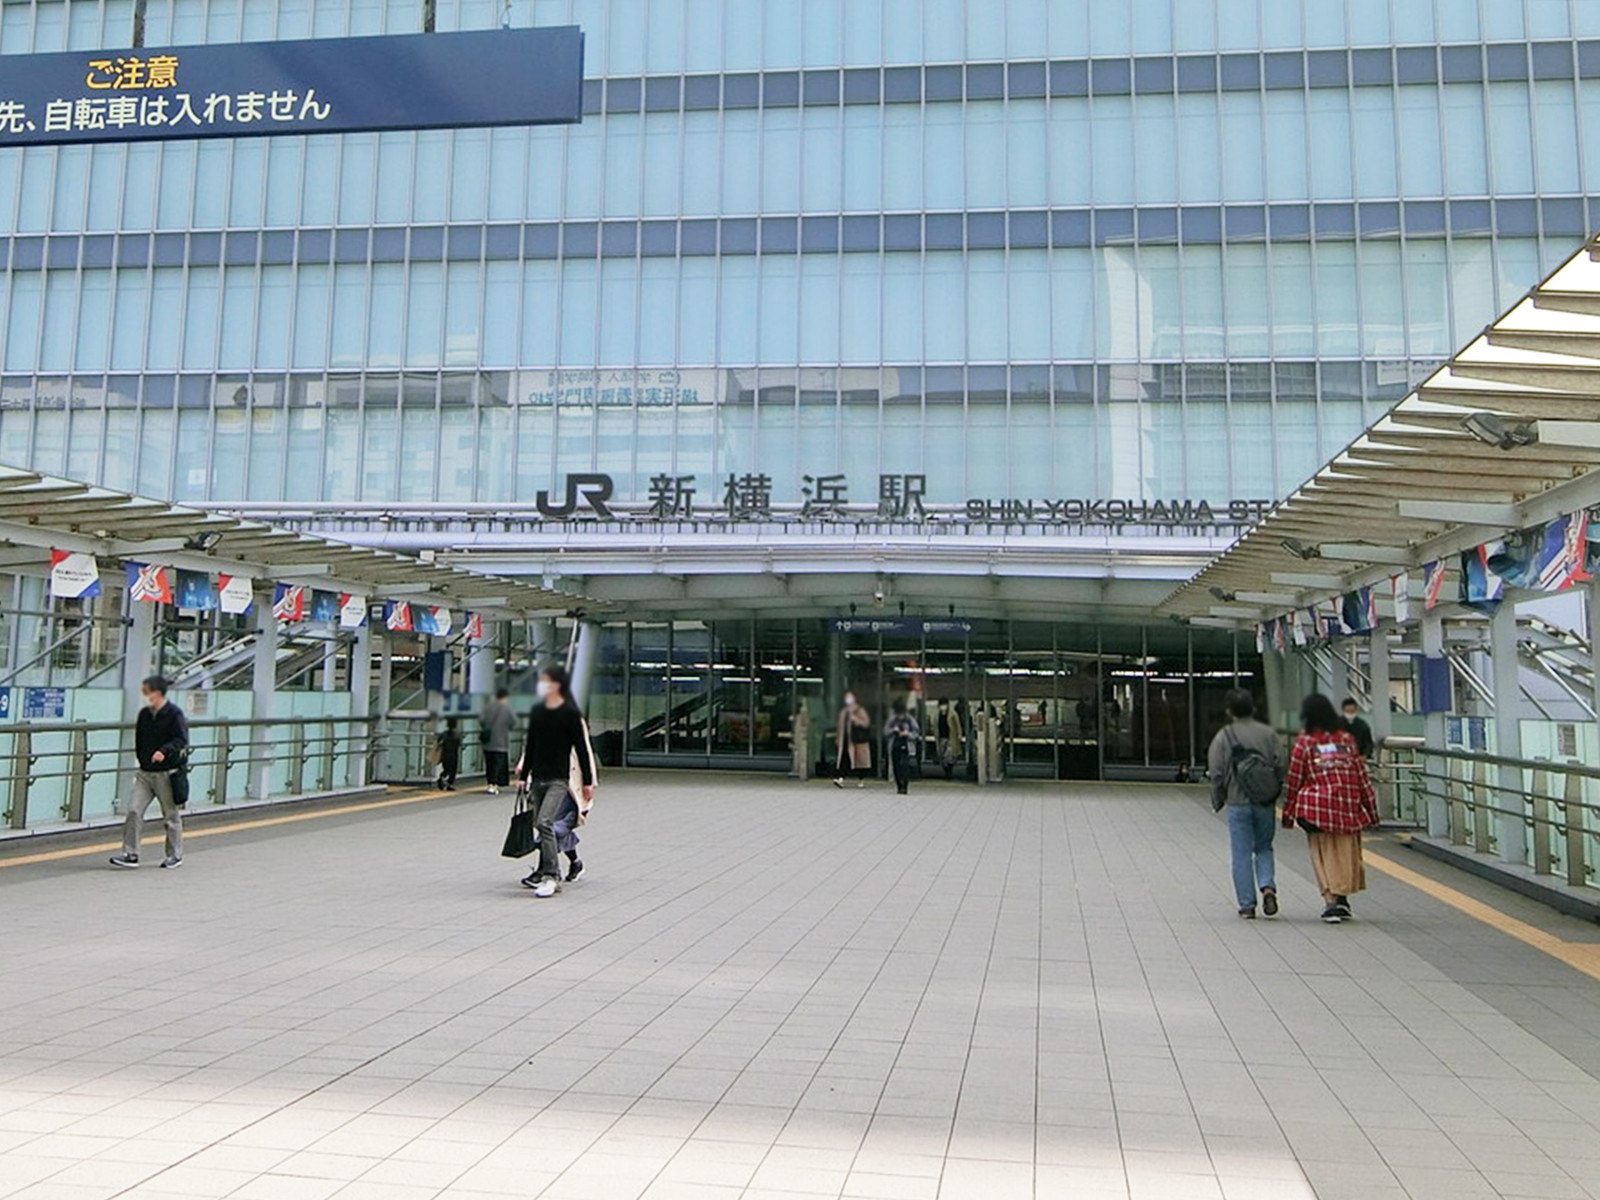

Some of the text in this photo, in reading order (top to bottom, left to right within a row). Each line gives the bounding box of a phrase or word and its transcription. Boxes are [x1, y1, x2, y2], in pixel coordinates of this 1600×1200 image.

[85, 55, 179, 90] ご注意
[536, 473, 926, 518] JR 新横浜駅
